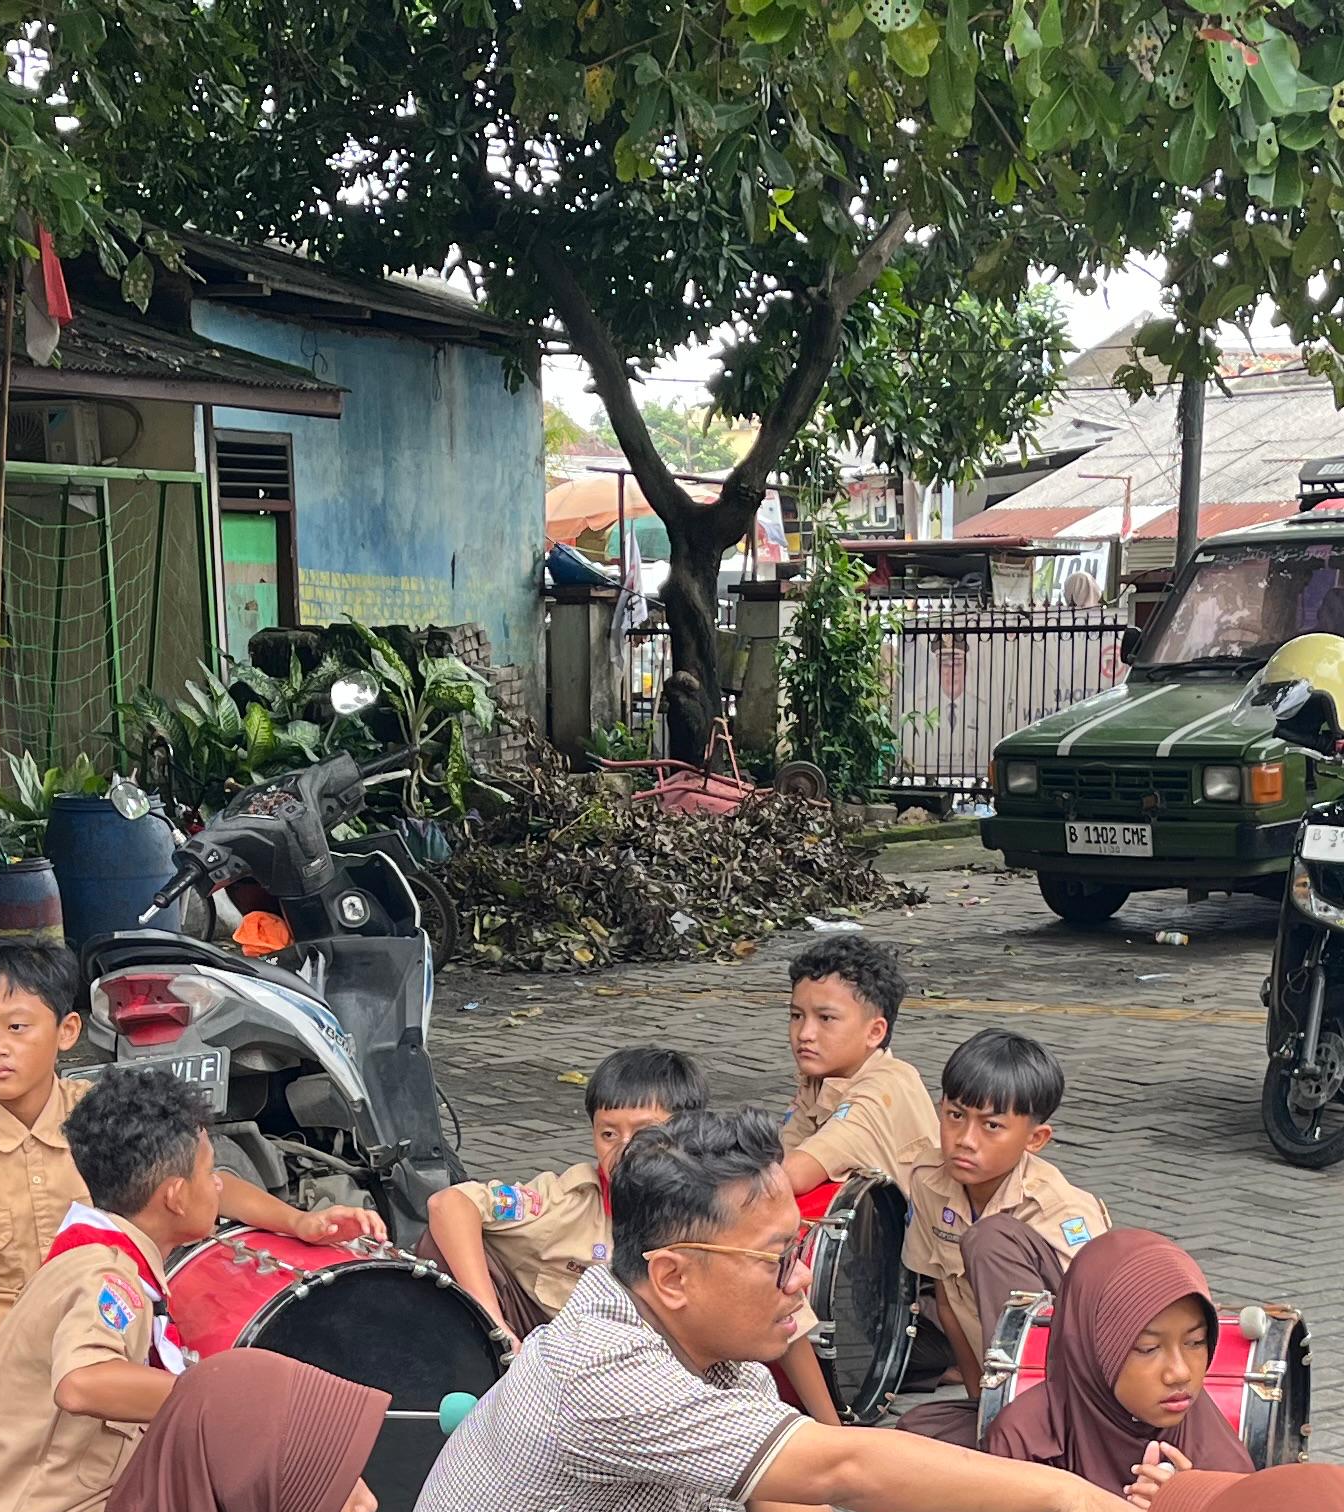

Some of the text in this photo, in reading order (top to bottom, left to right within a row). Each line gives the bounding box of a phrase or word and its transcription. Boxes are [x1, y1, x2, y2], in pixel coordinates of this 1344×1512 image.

[1069, 825, 1148, 846] B 1102 CME
[1312, 828, 1321, 841] B
